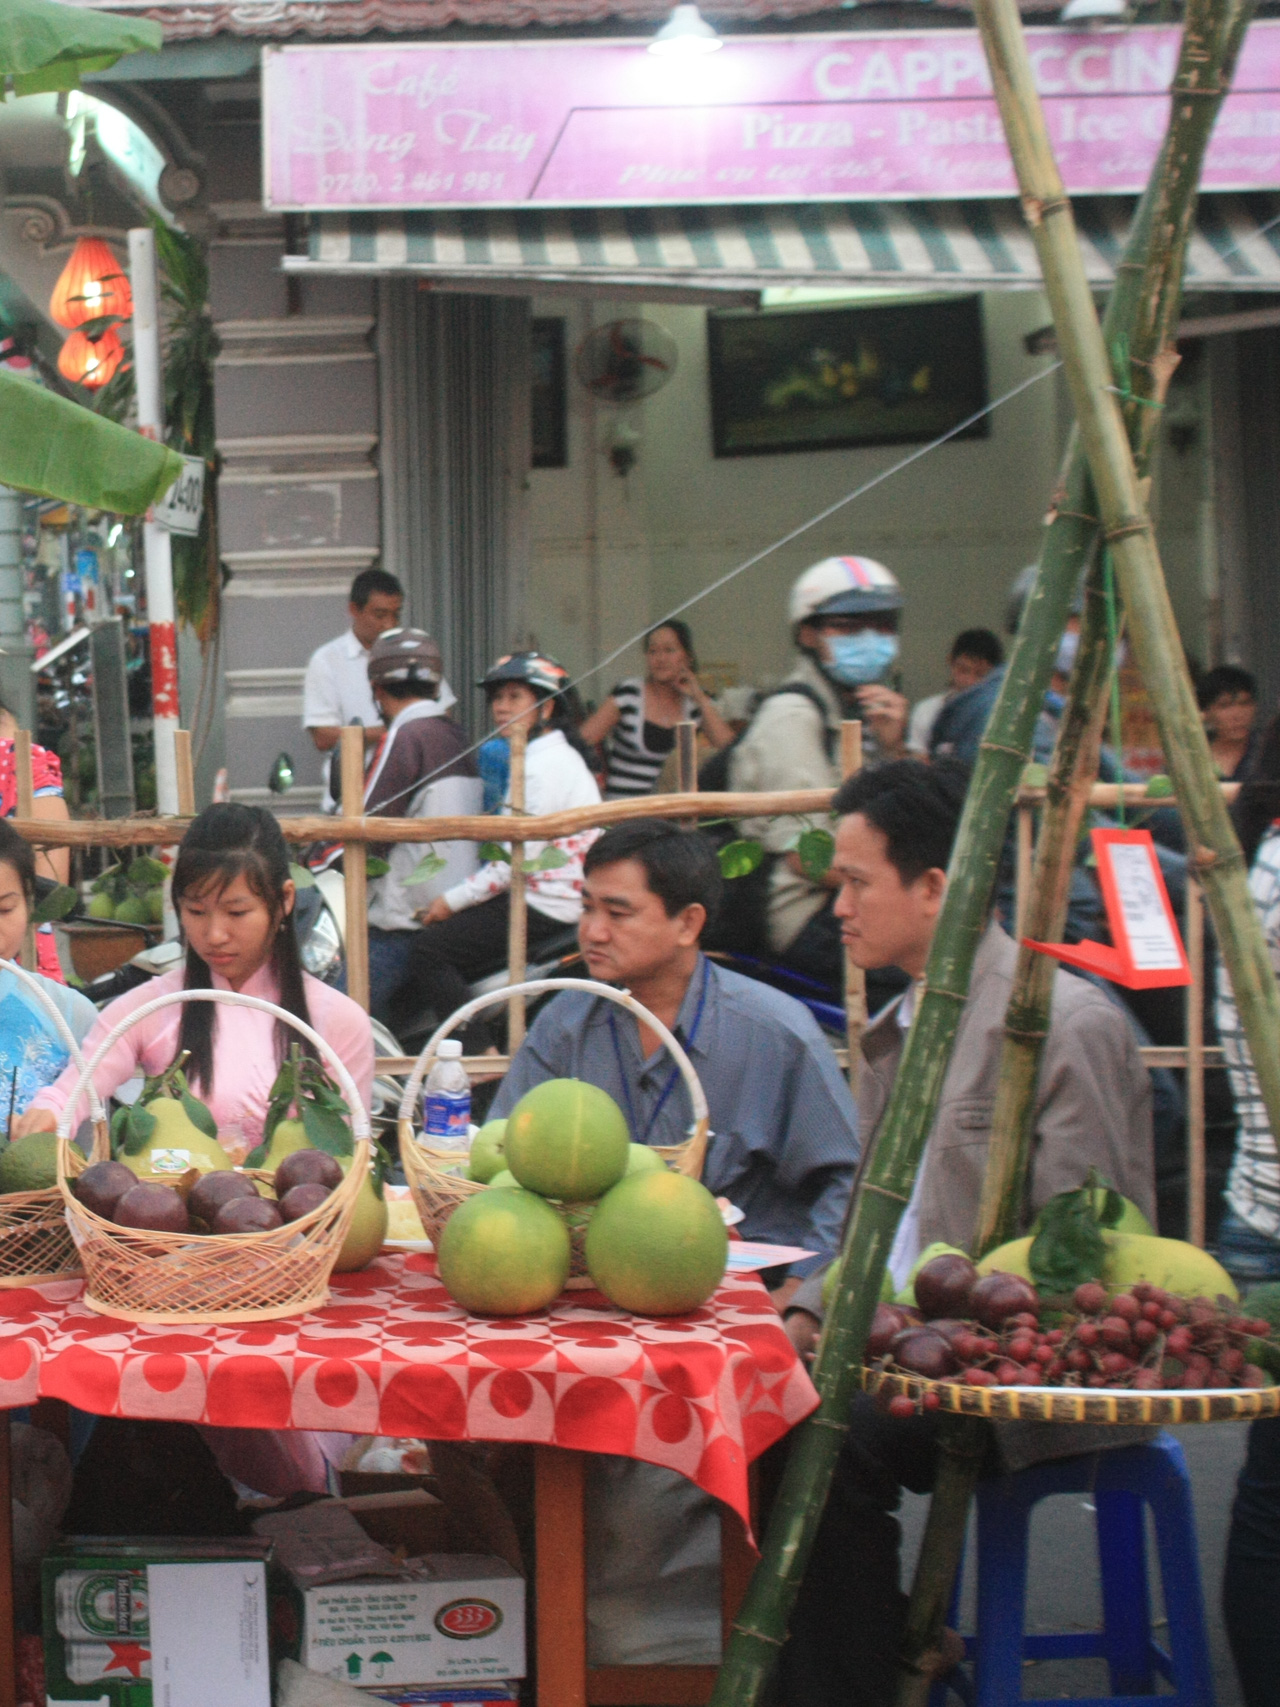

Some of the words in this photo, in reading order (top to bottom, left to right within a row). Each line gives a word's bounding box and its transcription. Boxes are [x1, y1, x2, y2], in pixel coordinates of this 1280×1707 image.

[813, 43, 1176, 97] CAPPCCIN
[741, 112, 855, 150] Pizza
[1061, 105, 1129, 142] Ice
